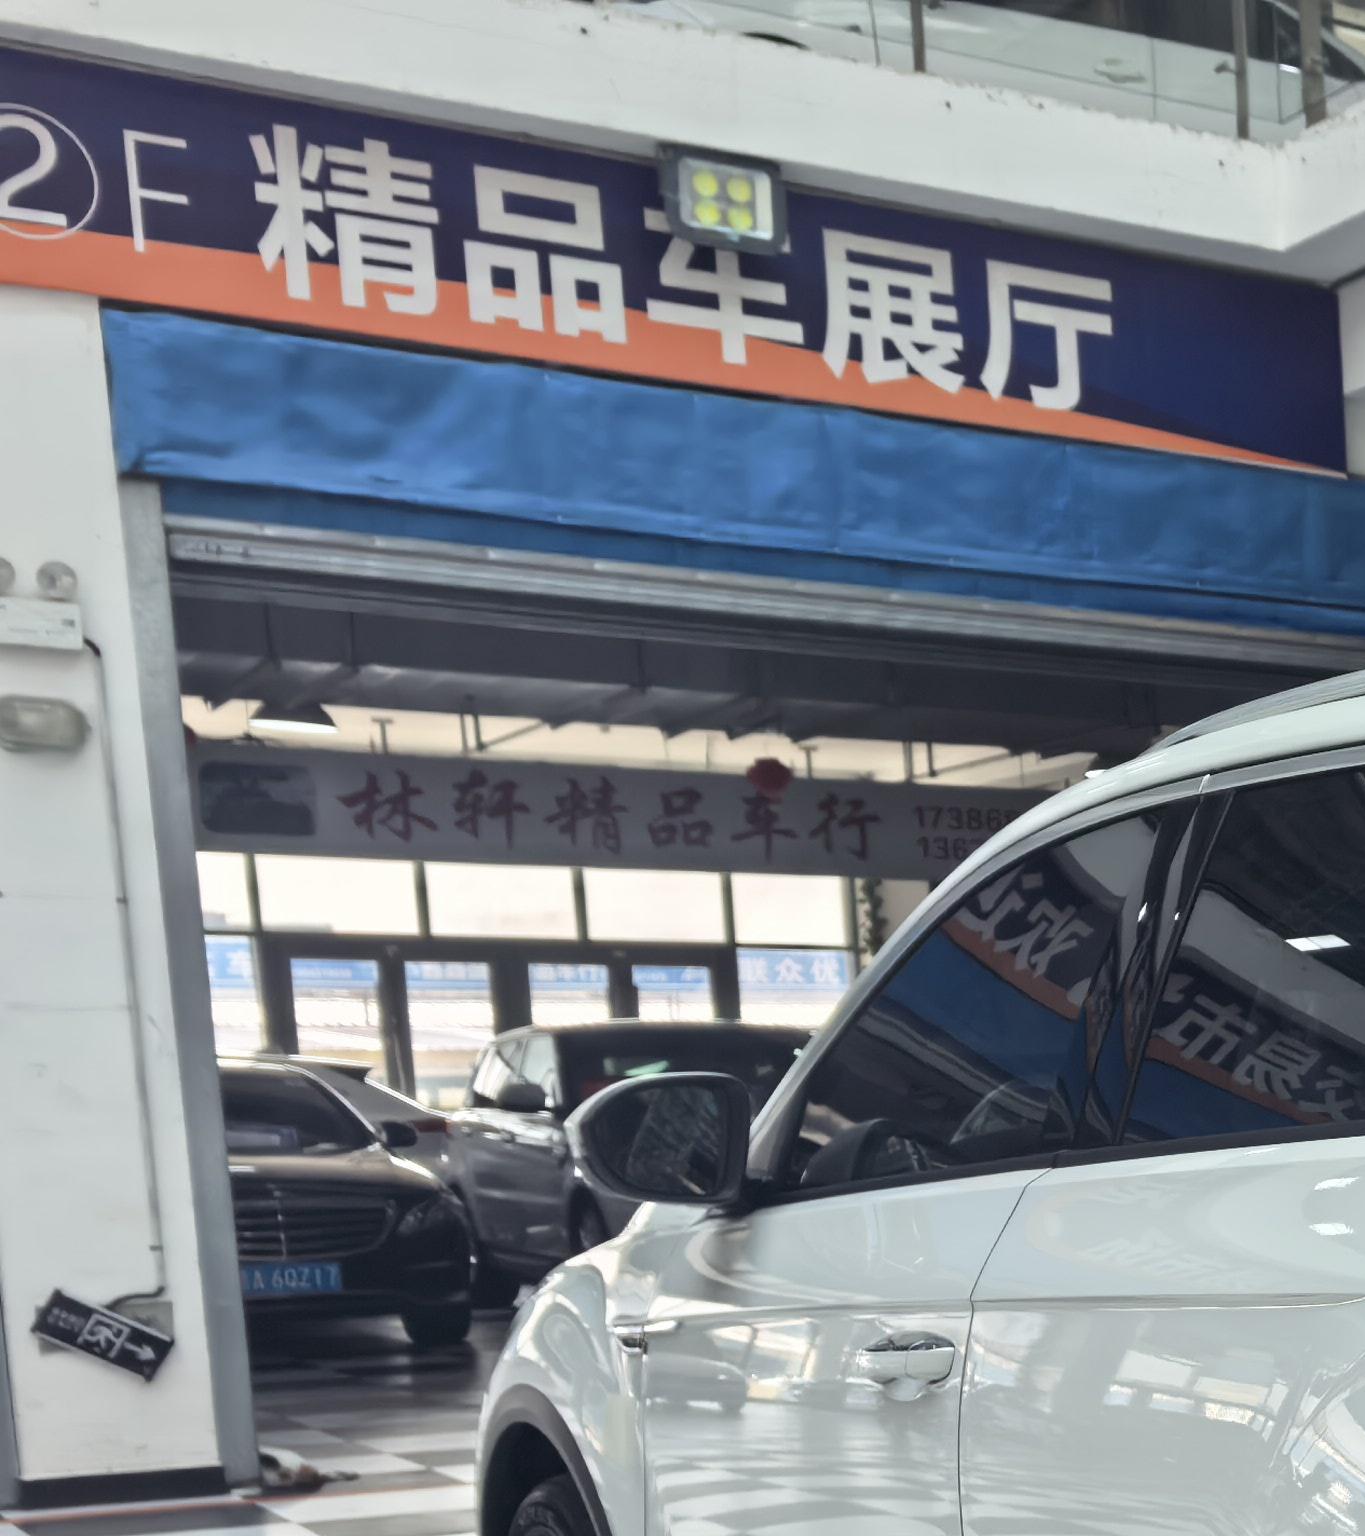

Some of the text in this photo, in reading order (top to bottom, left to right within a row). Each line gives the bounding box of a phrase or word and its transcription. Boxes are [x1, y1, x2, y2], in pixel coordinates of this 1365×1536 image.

[248, 124, 1113, 412] 精品车展厅
